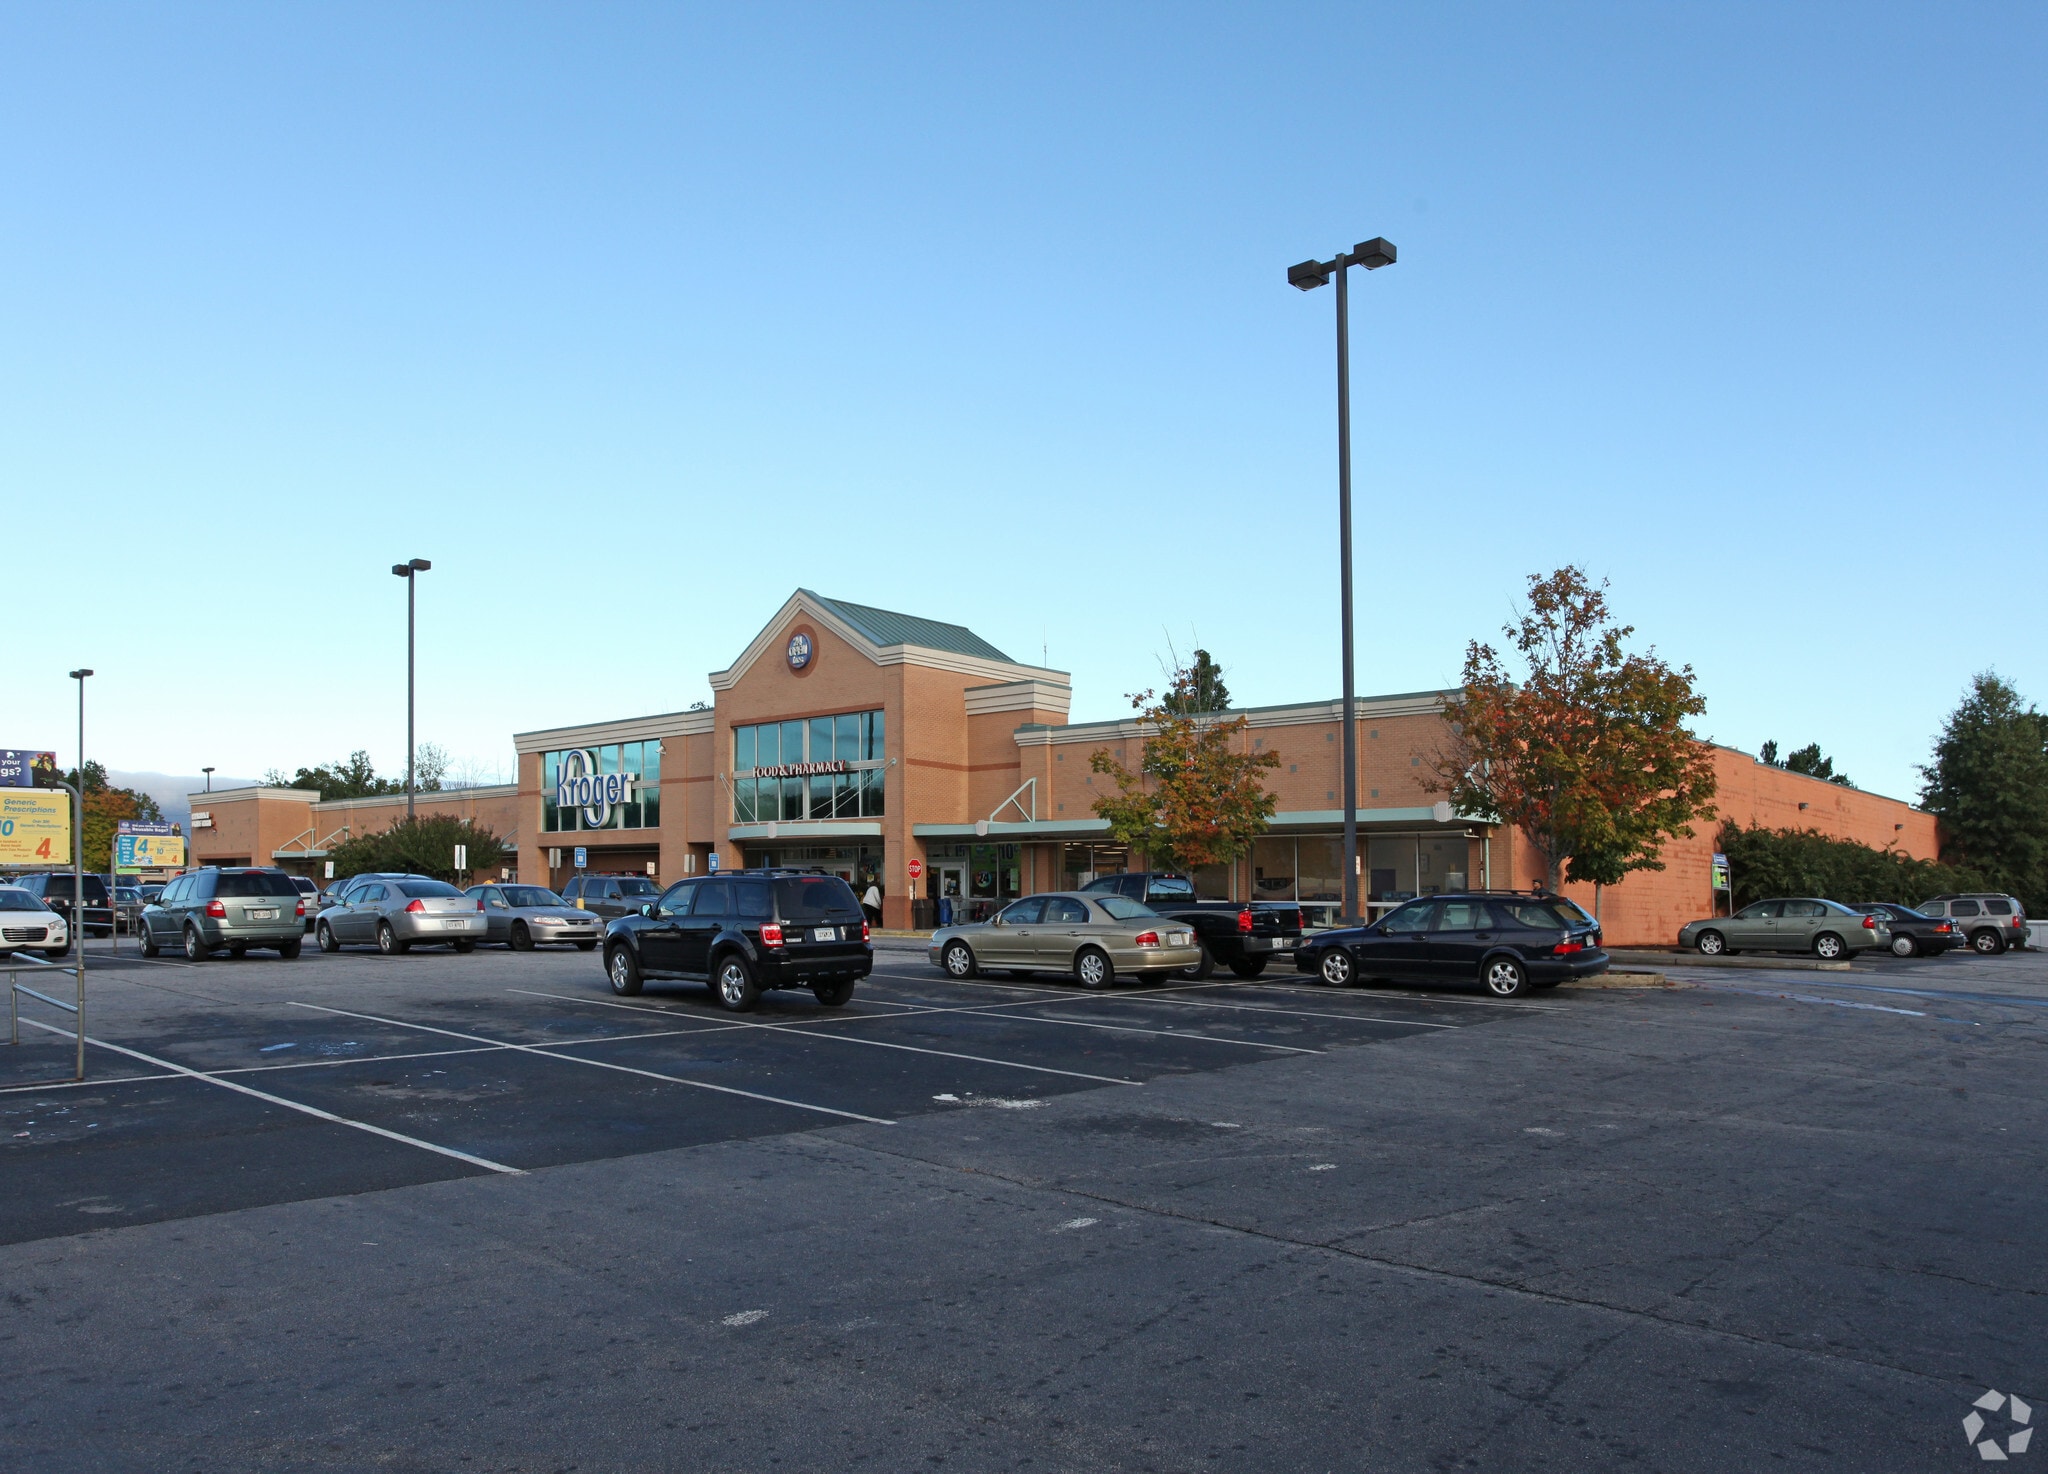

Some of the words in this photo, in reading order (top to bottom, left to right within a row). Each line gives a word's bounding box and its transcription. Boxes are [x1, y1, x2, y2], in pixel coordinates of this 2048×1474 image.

[556, 749, 634, 828] Kroger
[753, 766, 779, 777] FOOD
[780, 764, 788, 776] &
[789, 760, 845, 775] PHARMACY
